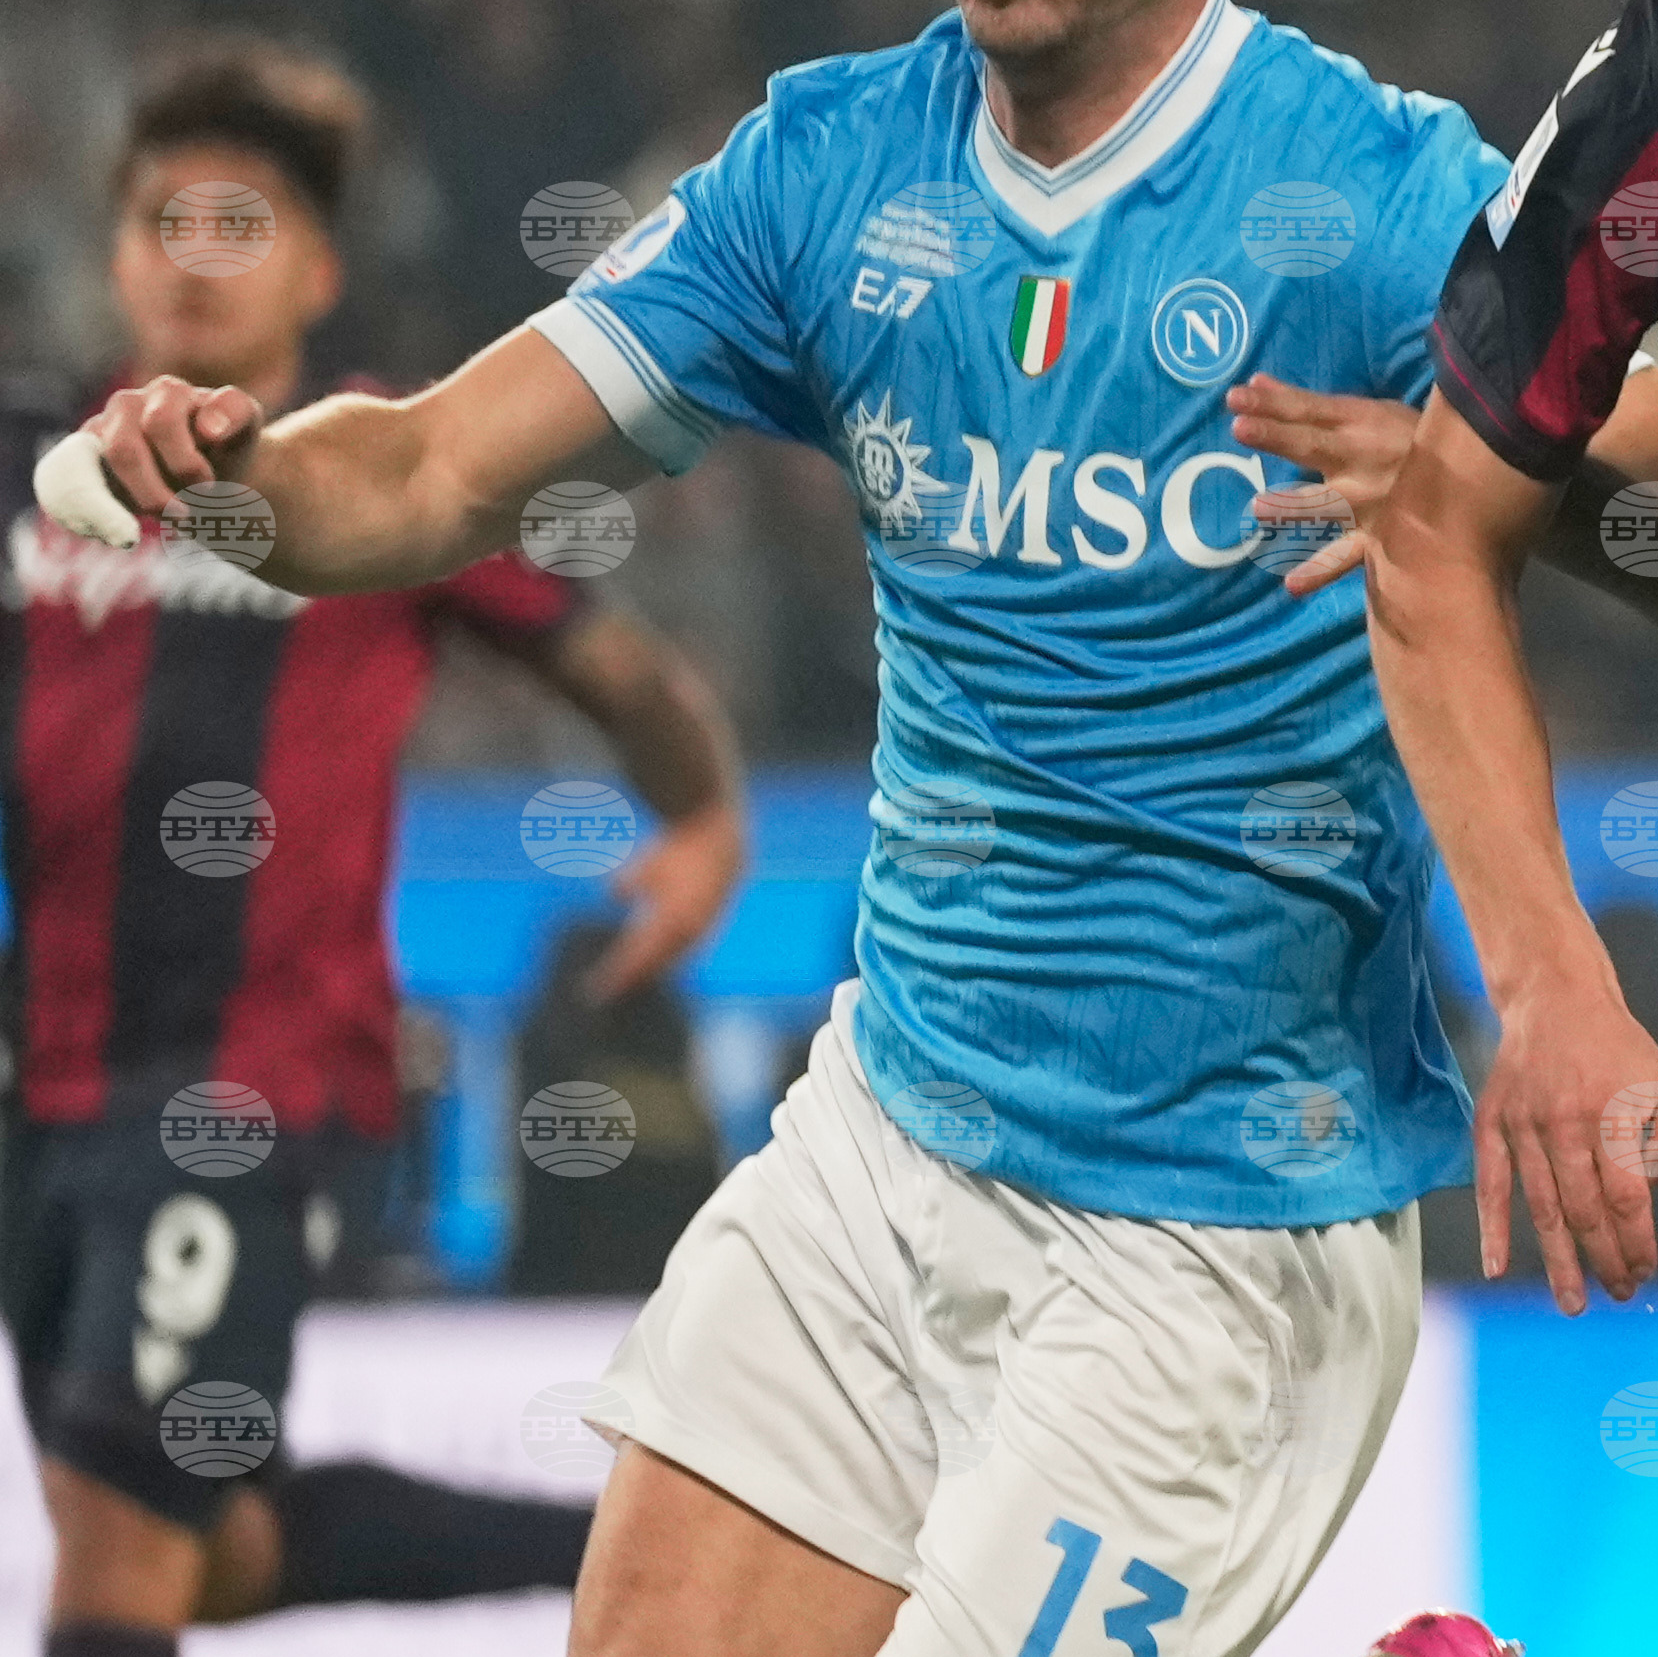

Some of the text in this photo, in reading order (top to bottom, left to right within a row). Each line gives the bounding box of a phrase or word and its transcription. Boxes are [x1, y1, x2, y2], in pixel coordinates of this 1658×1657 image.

[1180, 307, 1222, 358] N
[947, 433, 1268, 571] MSC
[137, 1190, 239, 1339] 9
